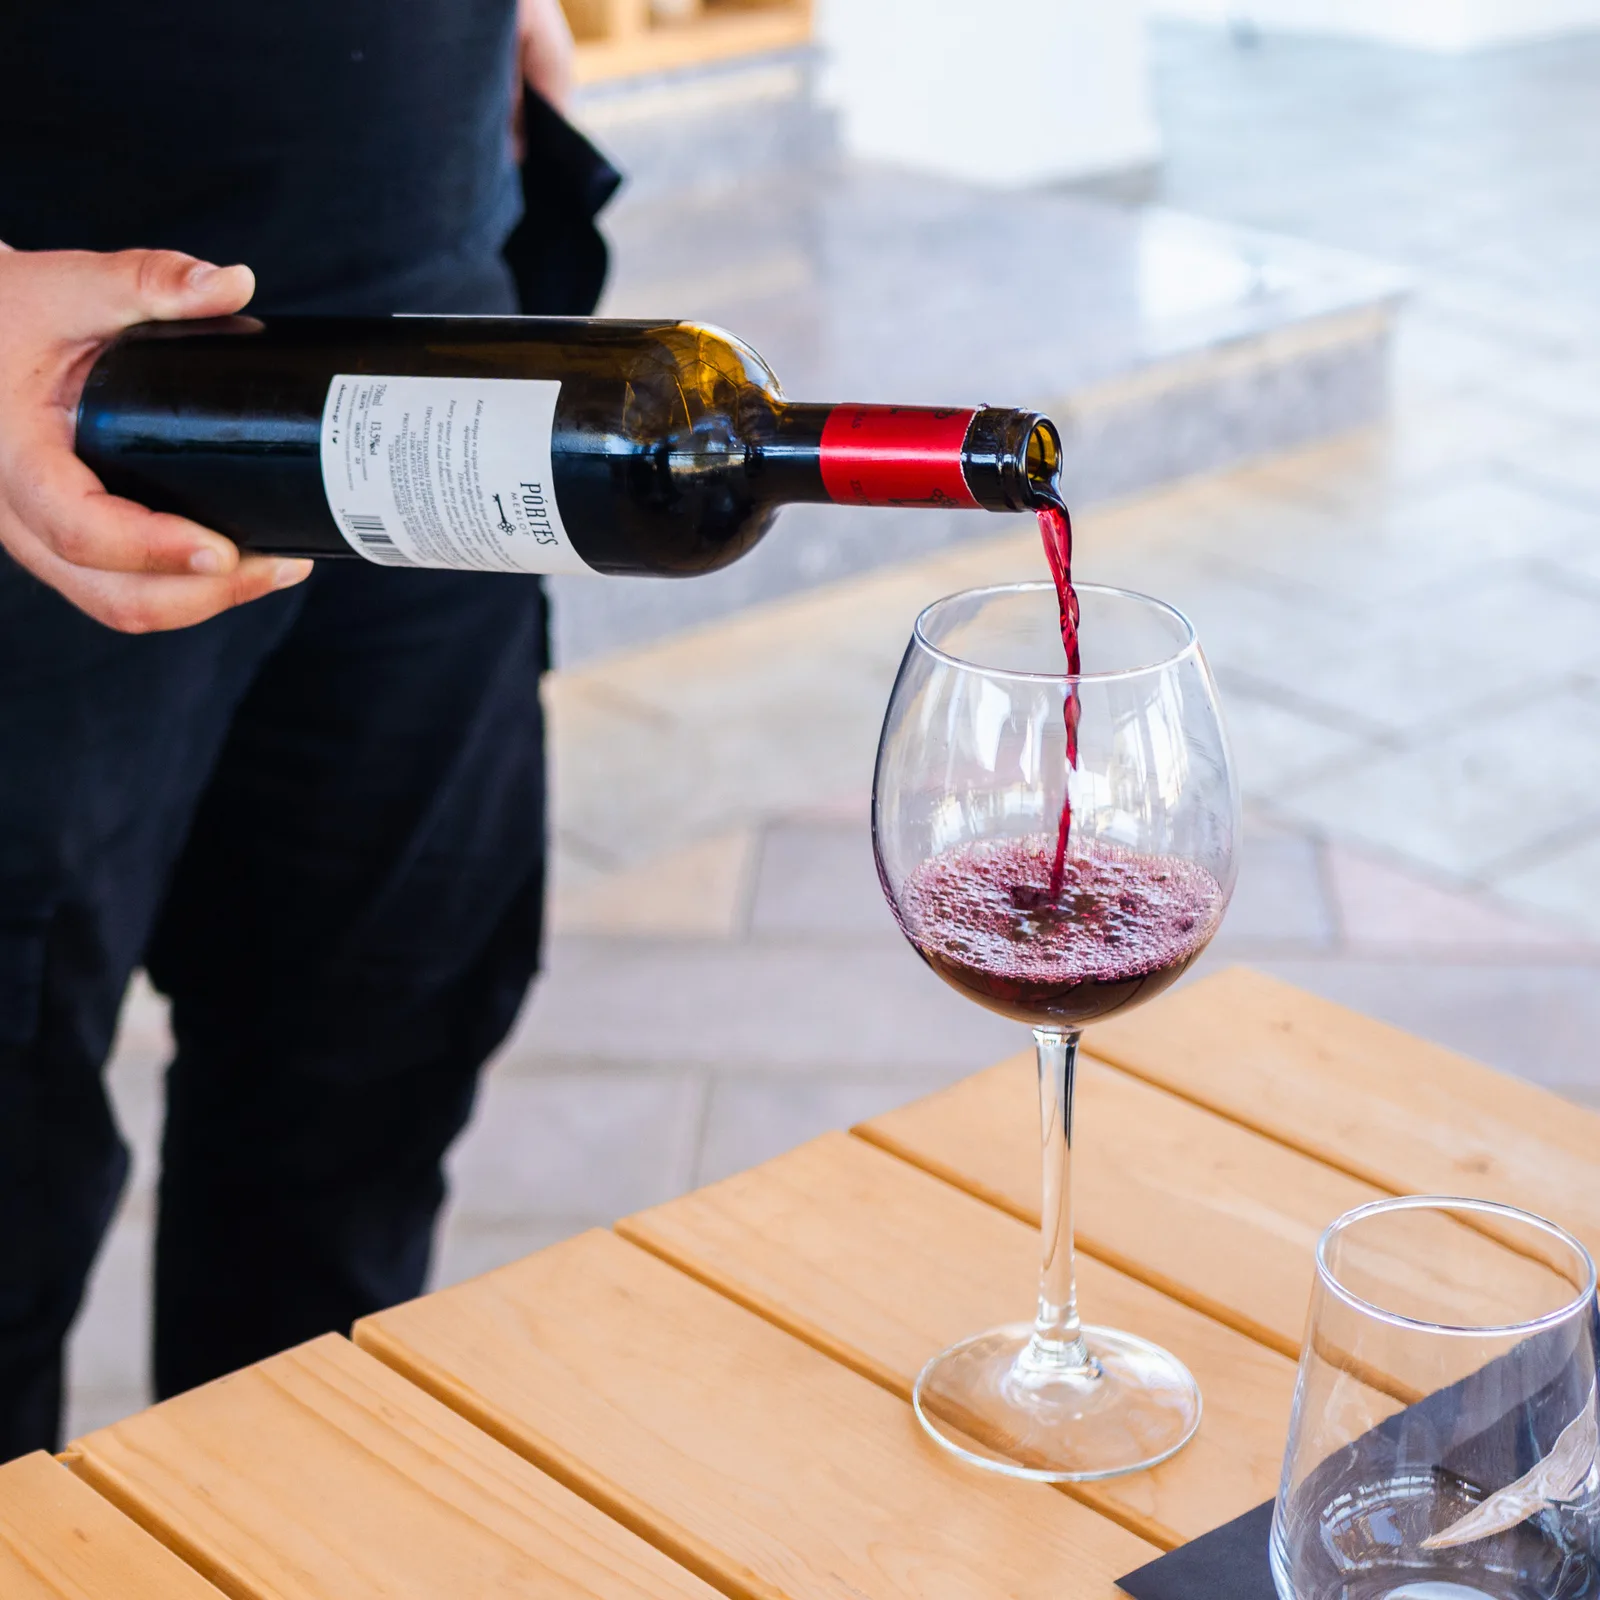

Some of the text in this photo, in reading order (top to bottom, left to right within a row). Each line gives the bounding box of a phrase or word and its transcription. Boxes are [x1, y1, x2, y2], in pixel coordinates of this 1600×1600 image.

[371, 384, 387, 407] 750ml
[401, 412, 411, 458] PROTECTED
[511, 492, 530, 537] MERLOT
[519, 482, 559, 546] PÓRTES
